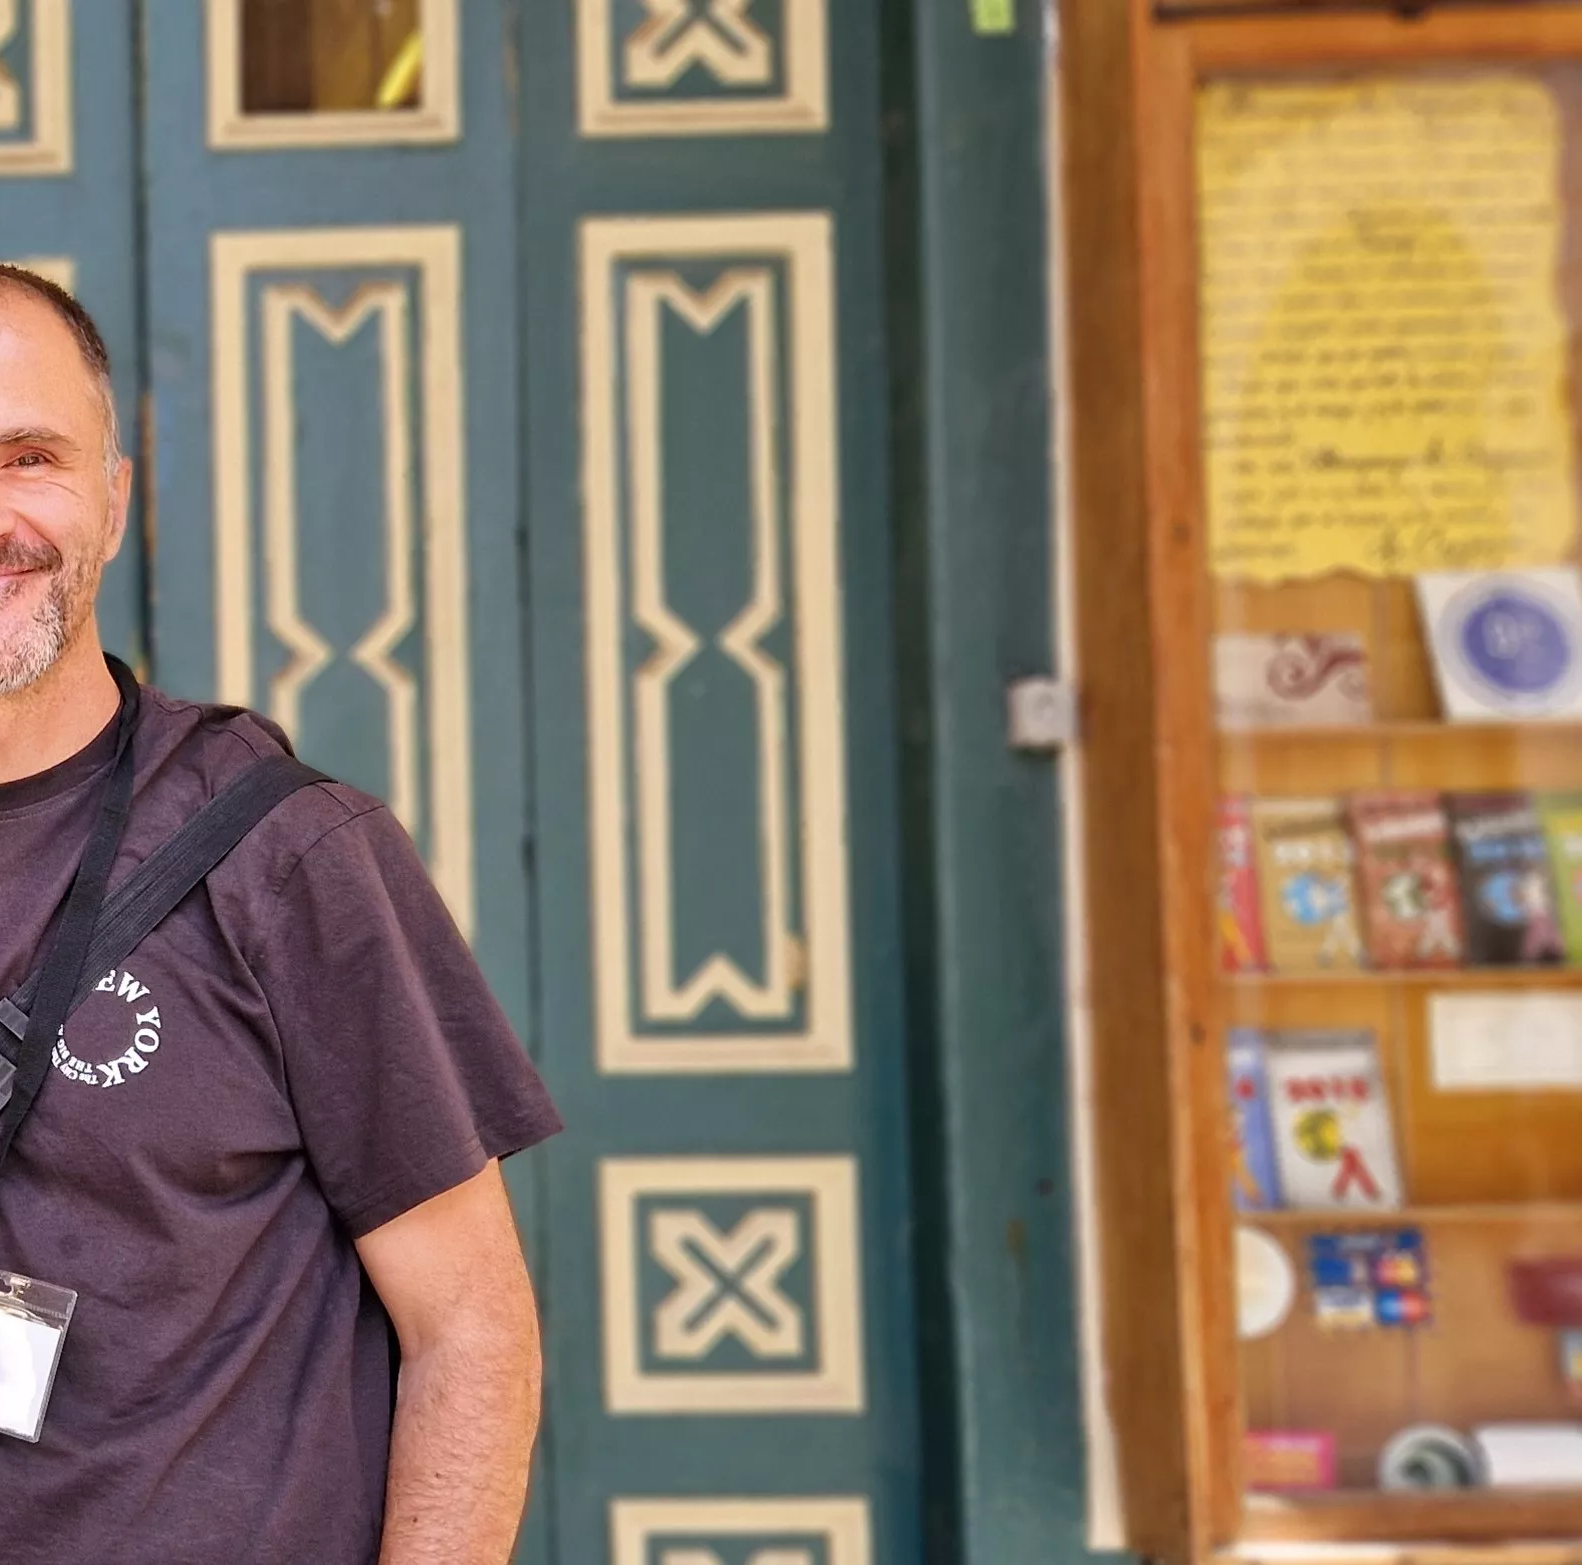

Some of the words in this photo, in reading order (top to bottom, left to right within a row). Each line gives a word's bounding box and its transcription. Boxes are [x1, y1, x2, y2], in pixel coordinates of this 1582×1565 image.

[94, 969, 151, 1003] EW
[57, 1038, 70, 1060] BIG
[95, 1006, 162, 1088] YORK
[68, 1056, 93, 1073] THE
